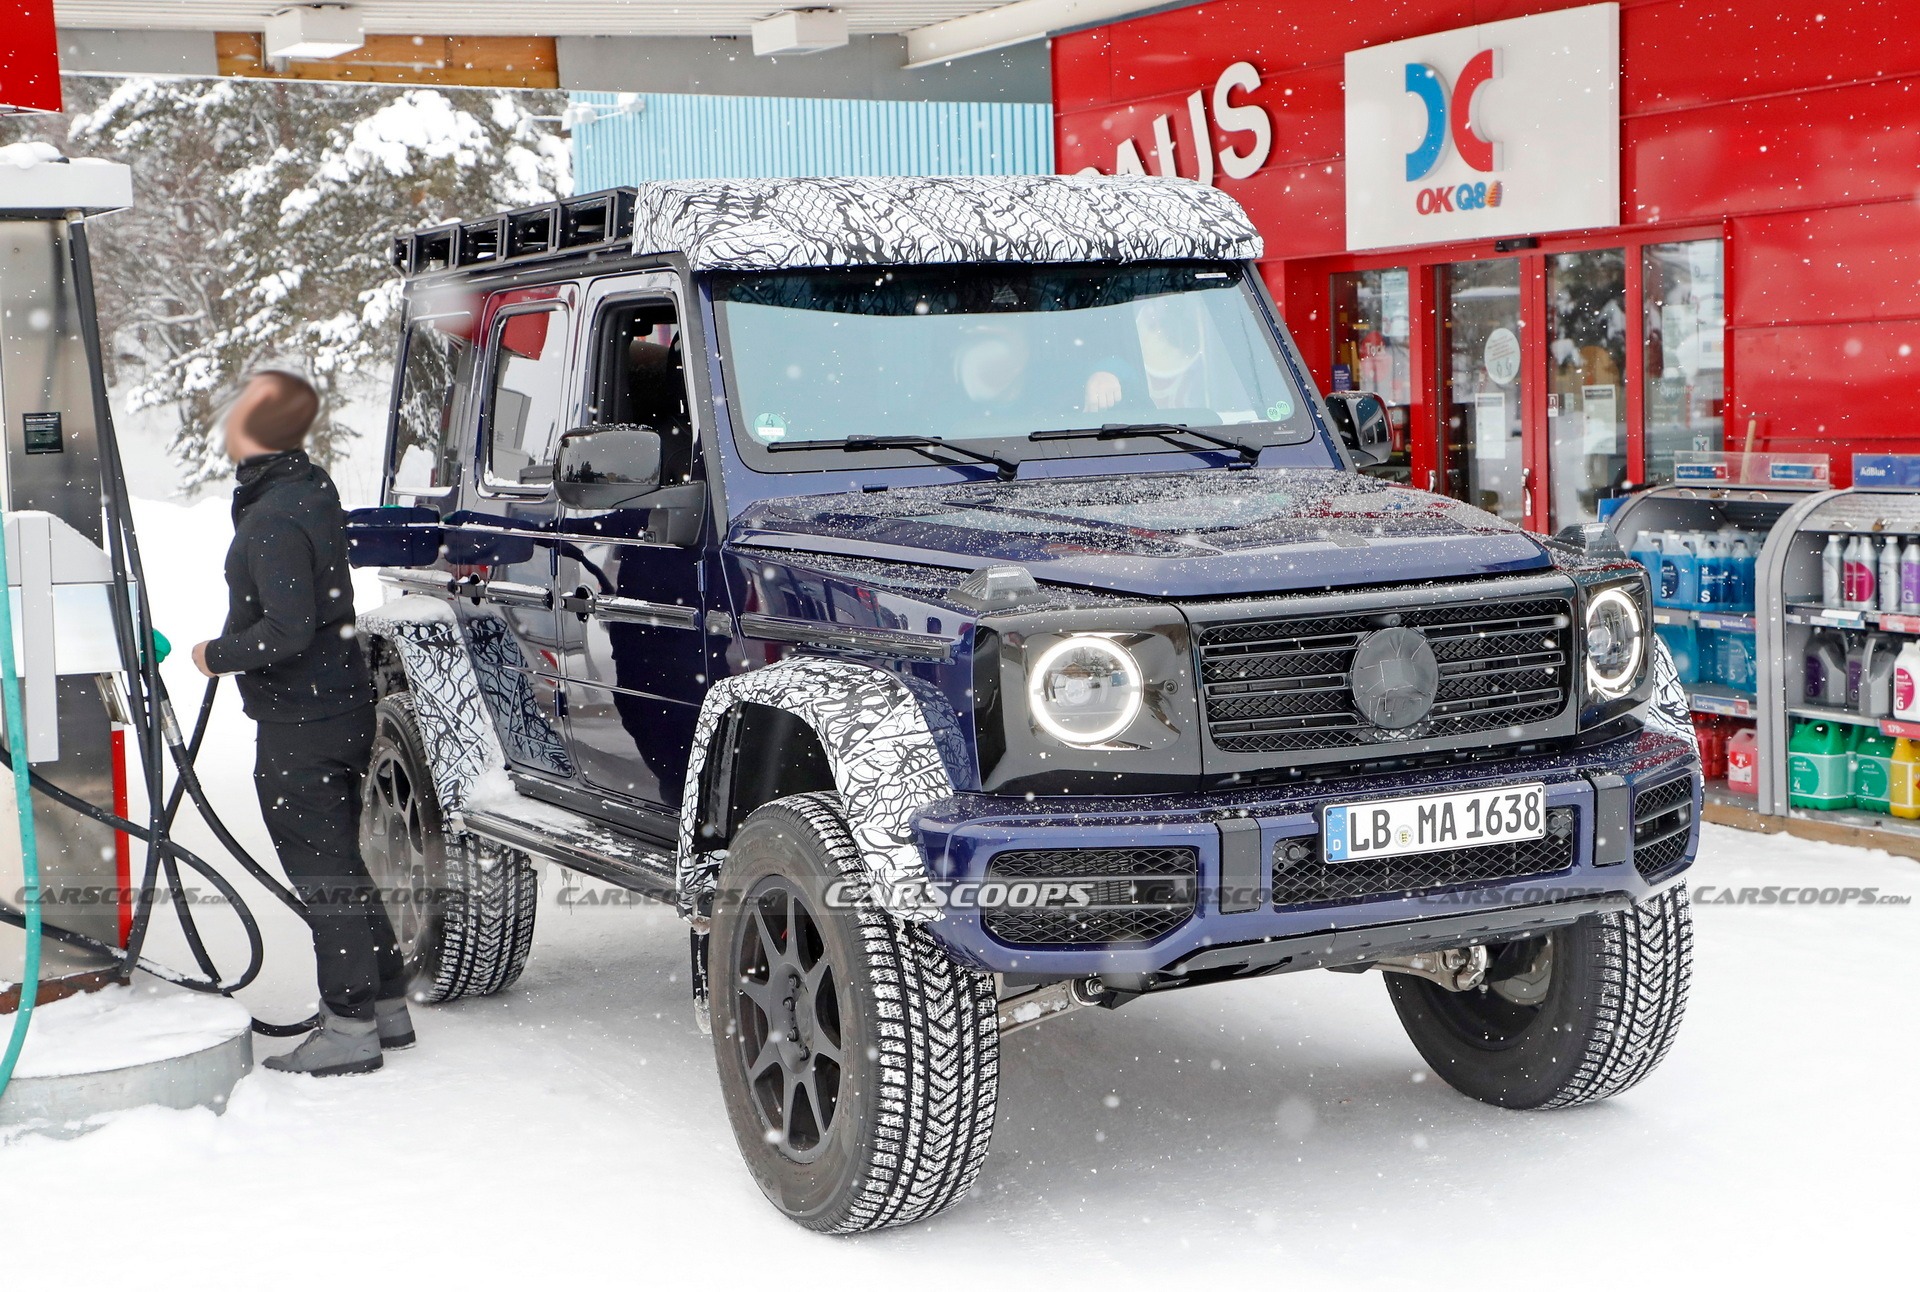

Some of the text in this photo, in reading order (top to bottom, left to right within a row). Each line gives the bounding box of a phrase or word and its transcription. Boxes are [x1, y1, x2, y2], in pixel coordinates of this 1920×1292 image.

[1860, 466, 1886, 477] AdBlue
[1350, 791, 1541, 852] LB MA 1638
[1333, 839, 1341, 851] D
